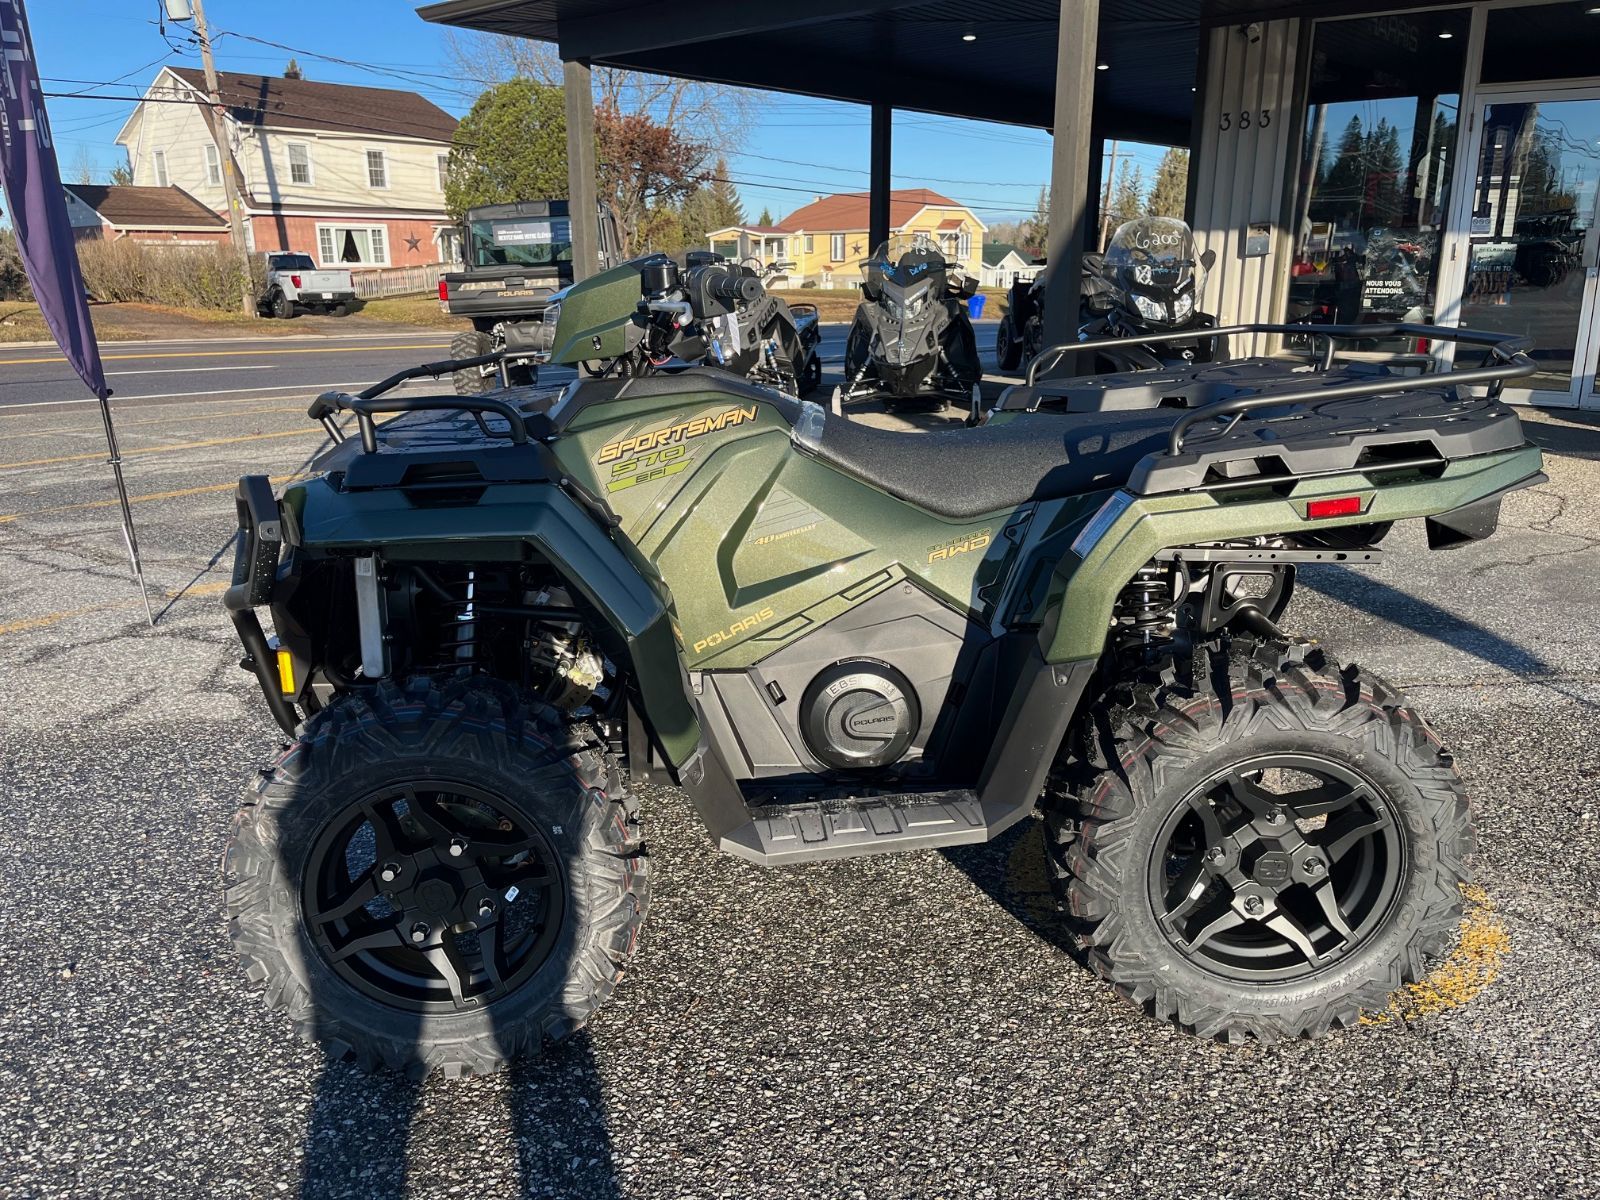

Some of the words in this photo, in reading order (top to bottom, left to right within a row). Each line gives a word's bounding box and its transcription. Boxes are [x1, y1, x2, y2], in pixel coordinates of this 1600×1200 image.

[598, 405, 759, 464] SPORTSMAN
[611, 444, 686, 477] 570
[754, 535, 774, 545] 40
[927, 535, 991, 565] AWD
[693, 606, 775, 654] POLARIS
[829, 676, 858, 696] EBS
[853, 715, 896, 727] POLARIS
